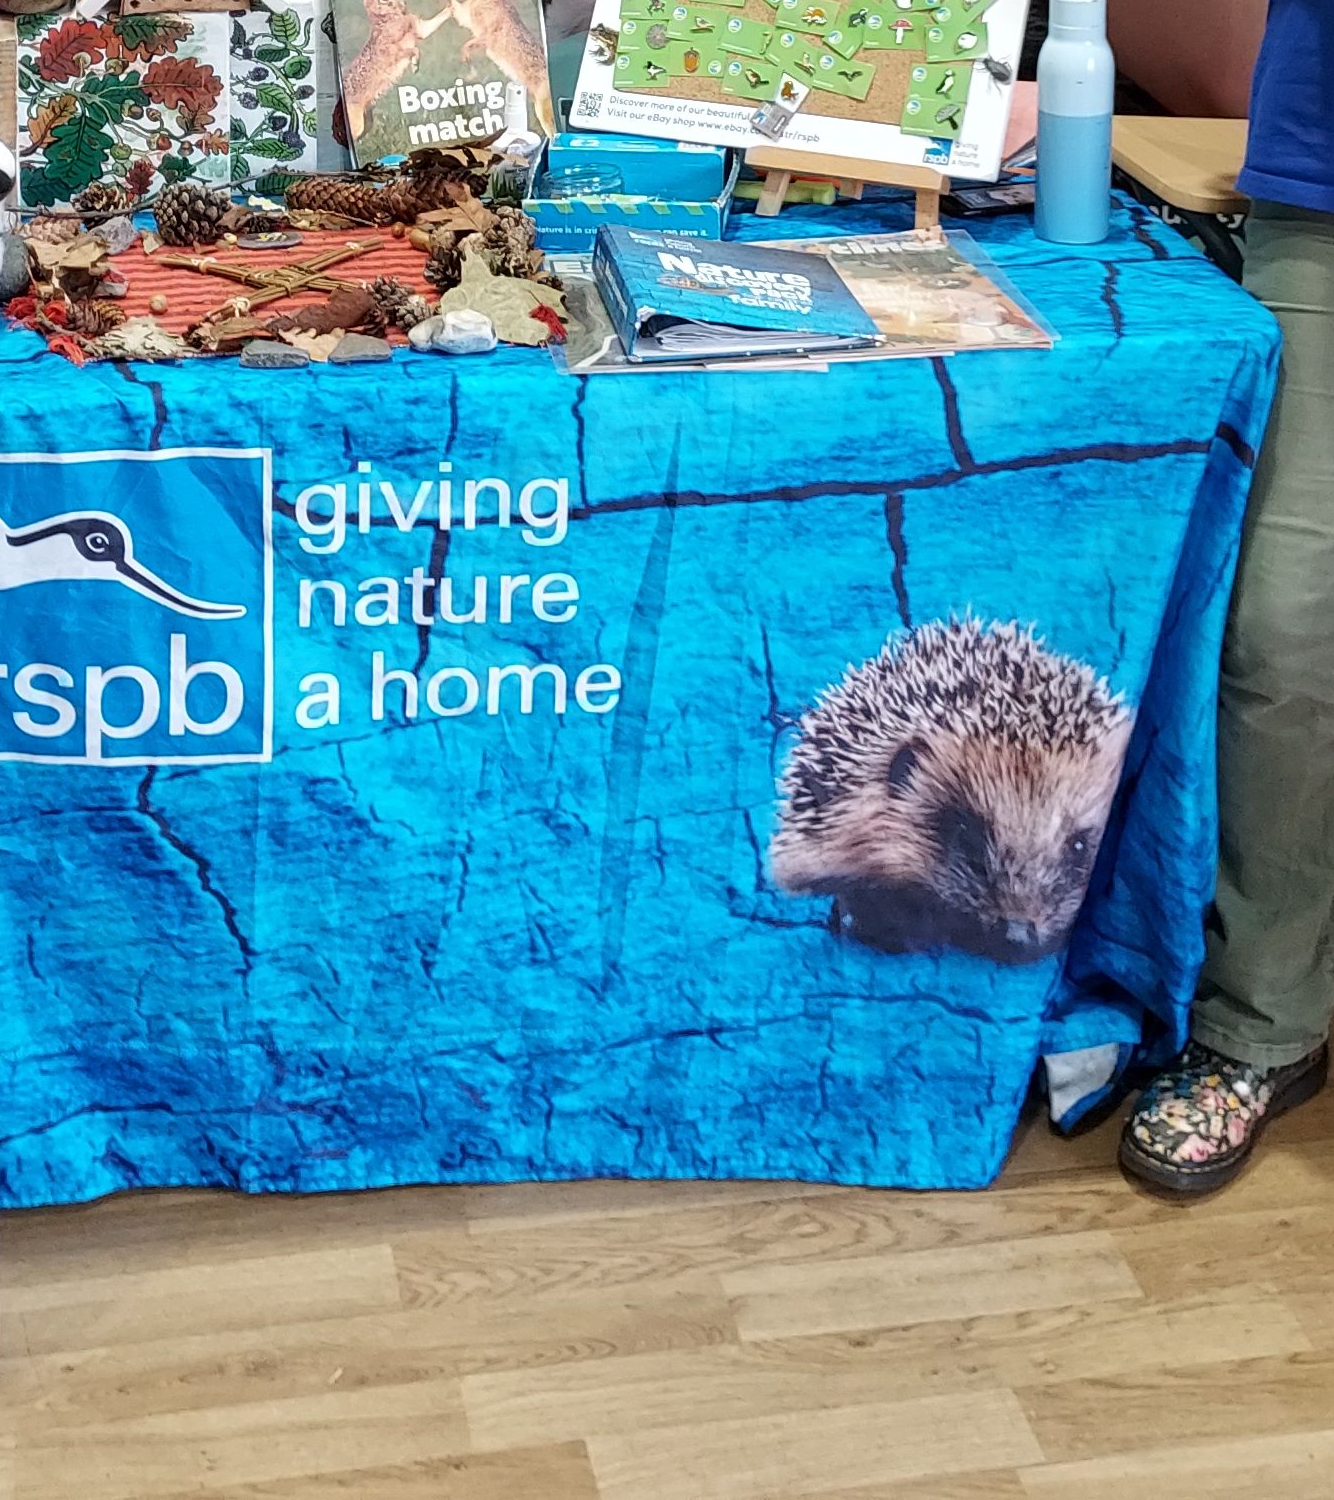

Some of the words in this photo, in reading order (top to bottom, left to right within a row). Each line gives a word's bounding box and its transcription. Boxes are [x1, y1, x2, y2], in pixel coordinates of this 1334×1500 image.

[398, 78, 505, 114] Boxing
[609, 96, 649, 108] Discover
[650, 102, 674, 112] more
[677, 104, 688, 114] of
[688, 107, 705, 116] our
[707, 107, 751, 121] beautiful
[407, 108, 506, 146] match
[607, 108, 628, 119] Visit
[629, 112, 646, 121] our
[647, 113, 671, 126] eBay
[672, 116, 696, 128] shop
[658, 252, 812, 287] Nature
[295, 461, 570, 555] giving
[298, 566, 580, 628] nature
[296, 673, 340, 730] a
[370, 651, 622, 719] home
